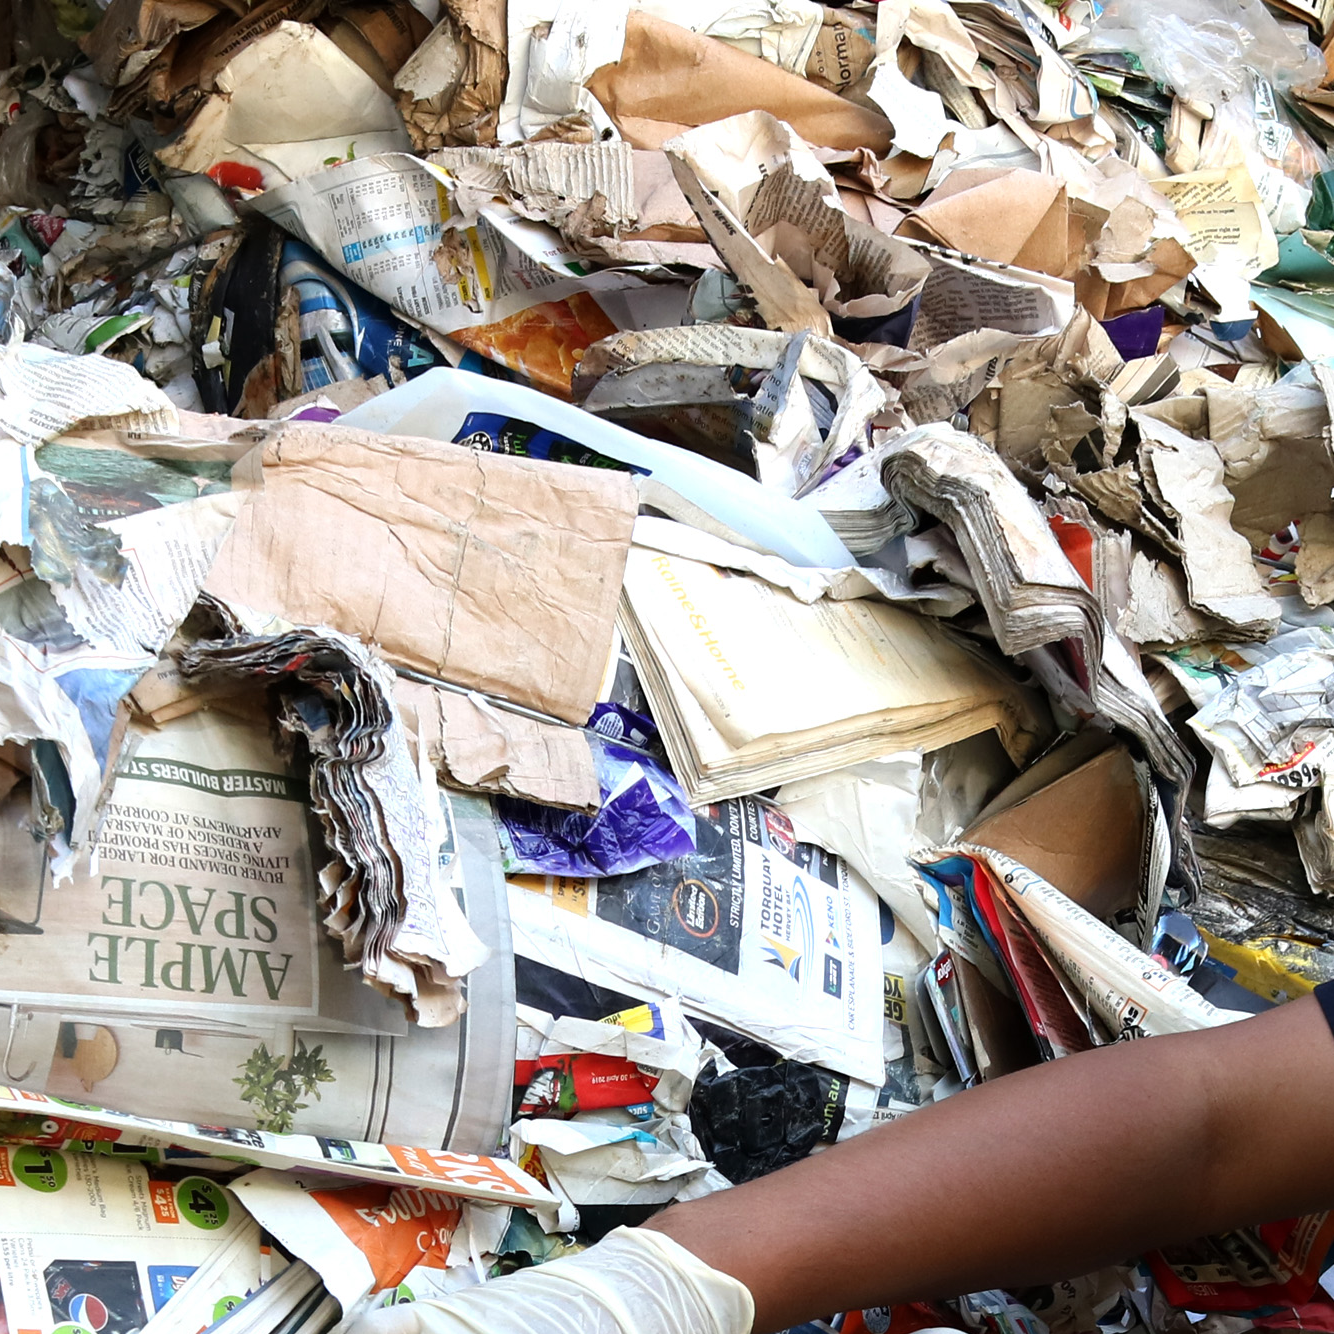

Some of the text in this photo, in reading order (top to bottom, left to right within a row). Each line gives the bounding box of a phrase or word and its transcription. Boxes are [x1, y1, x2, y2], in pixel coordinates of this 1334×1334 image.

[214, 24, 265, 58] YOUR MEAL
[151, 761, 287, 796] MASTER BUILDERS
[166, 826, 185, 840] OF
[173, 812, 282, 840] APARTMENTS AT
[187, 829, 254, 852] REDESIGN
[162, 842, 290, 870] LIVING SPACES HAS
[255, 841, 264, 854] A
[730, 838, 743, 886] LIMITED,
[149, 852, 284, 885] BUYER DEMAND FOR
[100, 875, 279, 944] SPACE
[686, 884, 699, 927] Limited
[729, 886, 743, 928] STRICTLY
[760, 853, 772, 930] TORQUAY
[694, 891, 707, 931] Edition
[772, 883, 784, 938] HOTEL
[784, 888, 792, 942] HERVEY BAY
[826, 895, 835, 930] KENO
[87, 932, 294, 1001] AMPLE
